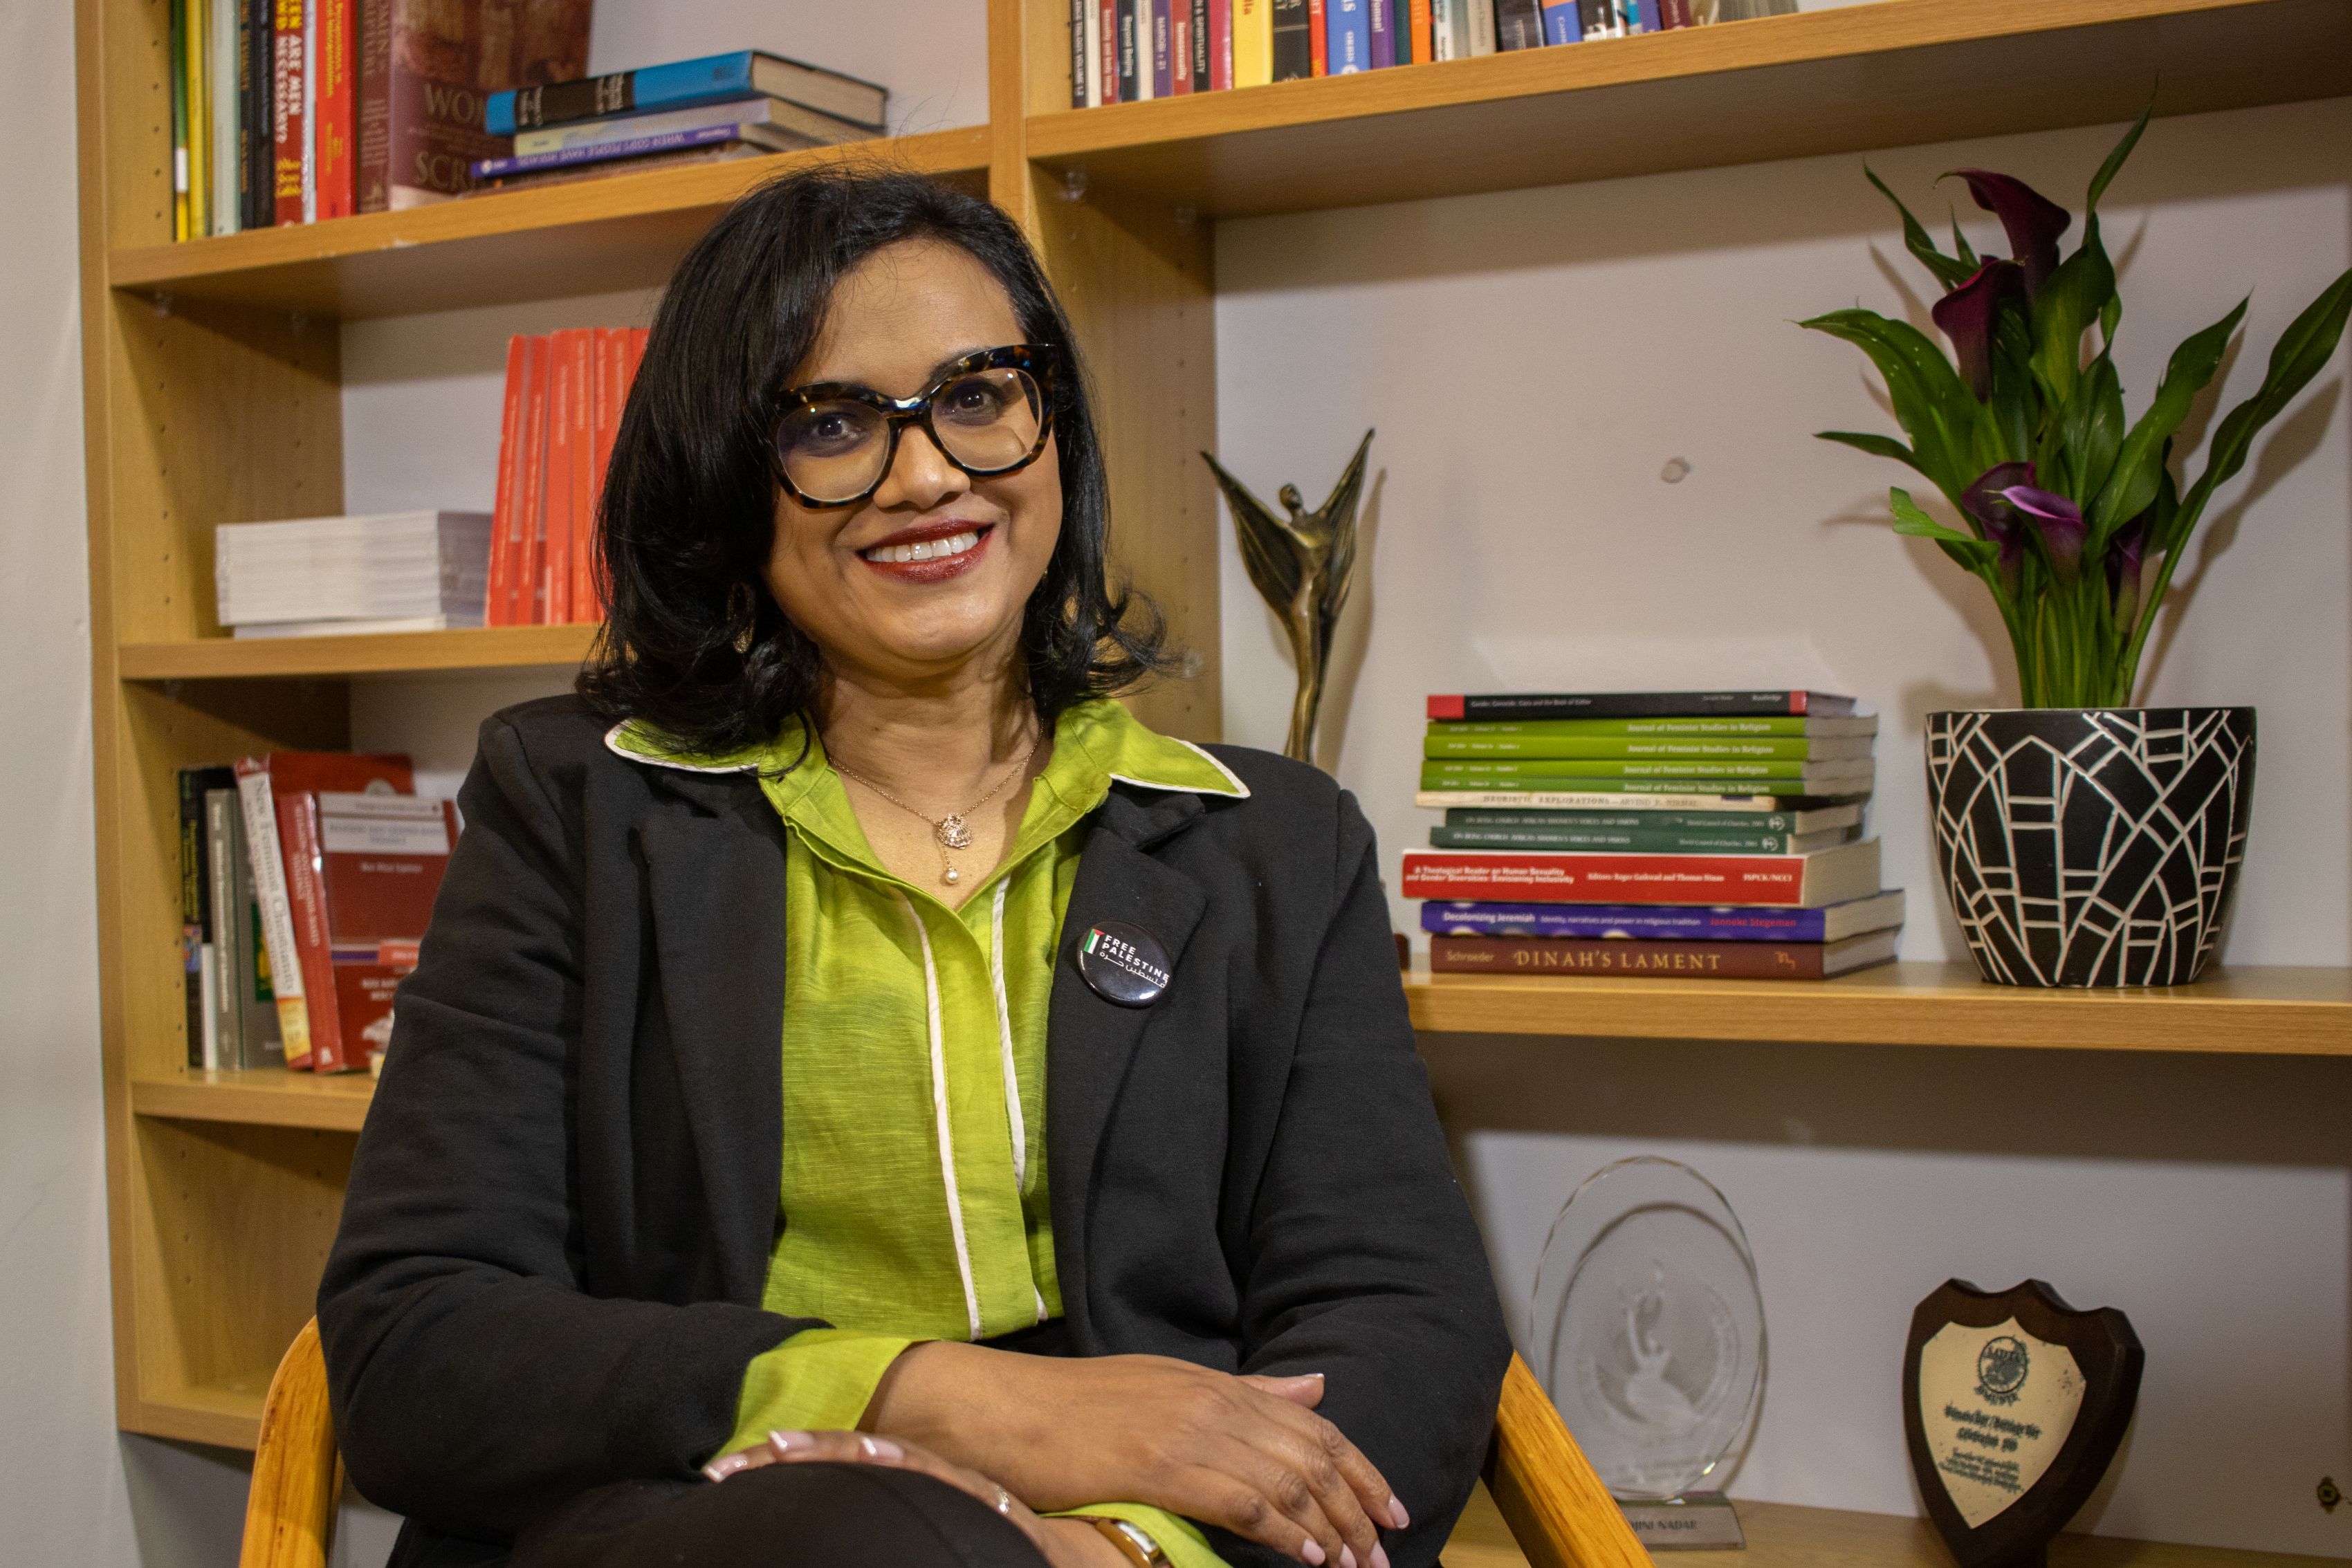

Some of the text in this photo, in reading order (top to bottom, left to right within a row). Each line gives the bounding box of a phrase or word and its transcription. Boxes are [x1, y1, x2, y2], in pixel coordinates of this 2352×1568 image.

[1122, 15, 1132, 47] Beyond
[1195, 16, 1206, 73] SPIRITUALITY
[1177, 22, 1187, 80] Homosexuality
[1075, 54, 1084, 84] VOLUME
[288, 35, 302, 115] ARE MEN
[276, 36, 288, 143] NECESSARY?
[1628, 723, 1655, 732] Journal
[1667, 723, 1698, 732] Feminist
[1700, 723, 1727, 732] Studies
[1740, 723, 1771, 733] Religion
[1628, 745, 1655, 753] Journal
[1668, 745, 1700, 753] Feminist
[1702, 745, 1730, 753] Studies
[1742, 745, 1774, 755] Religion
[1624, 766, 1651, 774] Journal
[1664, 766, 1695, 774] Feminist
[1698, 766, 1724, 774] Studies
[1737, 766, 1768, 776] Religion
[1624, 784, 1651, 792] Journal
[1664, 784, 1696, 792] Feminist
[1698, 784, 1725, 792] Studies
[1738, 784, 1770, 794] Religion
[1423, 867, 1462, 876] Theological
[1464, 867, 1490, 875] Reader
[1530, 867, 1565, 877] Sexuality
[1536, 876, 1574, 885] Inclusivity
[1614, 874, 1633, 883] Roger
[1677, 874, 1702, 882] Thomas
[1443, 912, 1536, 923] Decolonizing Jeremiah
[1615, 918, 1635, 926] power
[1644, 917, 1671, 927] religious
[1710, 918, 1796, 928] Janneke Stegeman
[1104, 934, 1137, 955] FREE
[1101, 942, 1170, 981] PALESTINE
[1446, 951, 1494, 962] Schroeder
[1513, 950, 1721, 969] DINAH'S LAMENT
[1099, 950, 1168, 988] فلسطين حرة
